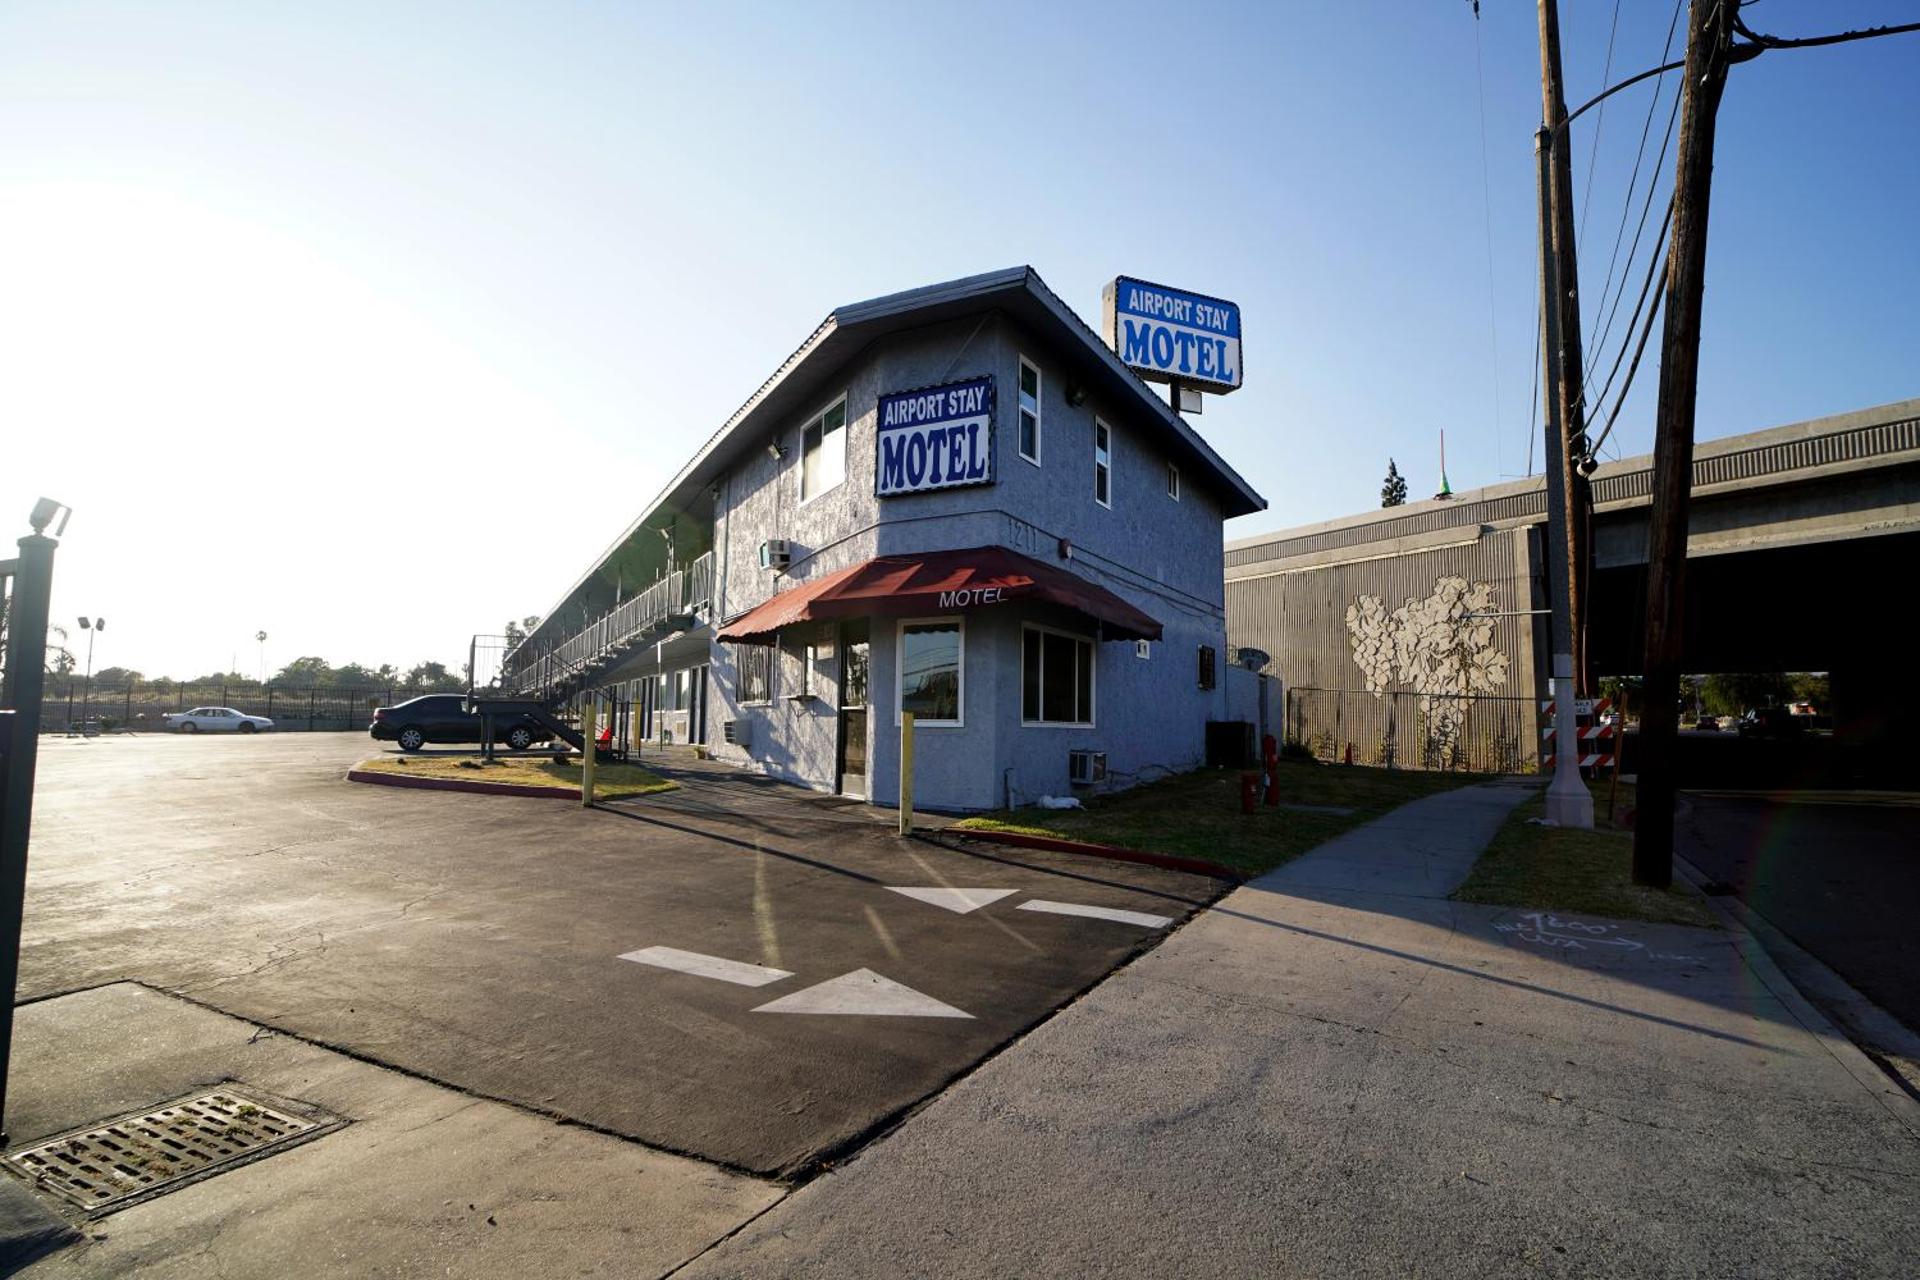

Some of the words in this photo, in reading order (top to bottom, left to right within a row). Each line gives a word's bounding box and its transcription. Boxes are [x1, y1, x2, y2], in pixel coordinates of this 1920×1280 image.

[1129, 288, 1192, 322] AIRPORT
[1195, 304, 1230, 331] STAY
[1123, 319, 1233, 382] MOTEL
[884, 393, 945, 426] AIRPORT
[948, 386, 985, 416] STAY
[881, 423, 985, 491] MOTEL
[1008, 518, 1037, 552] 1211
[940, 588, 1009, 608] MOTEL
